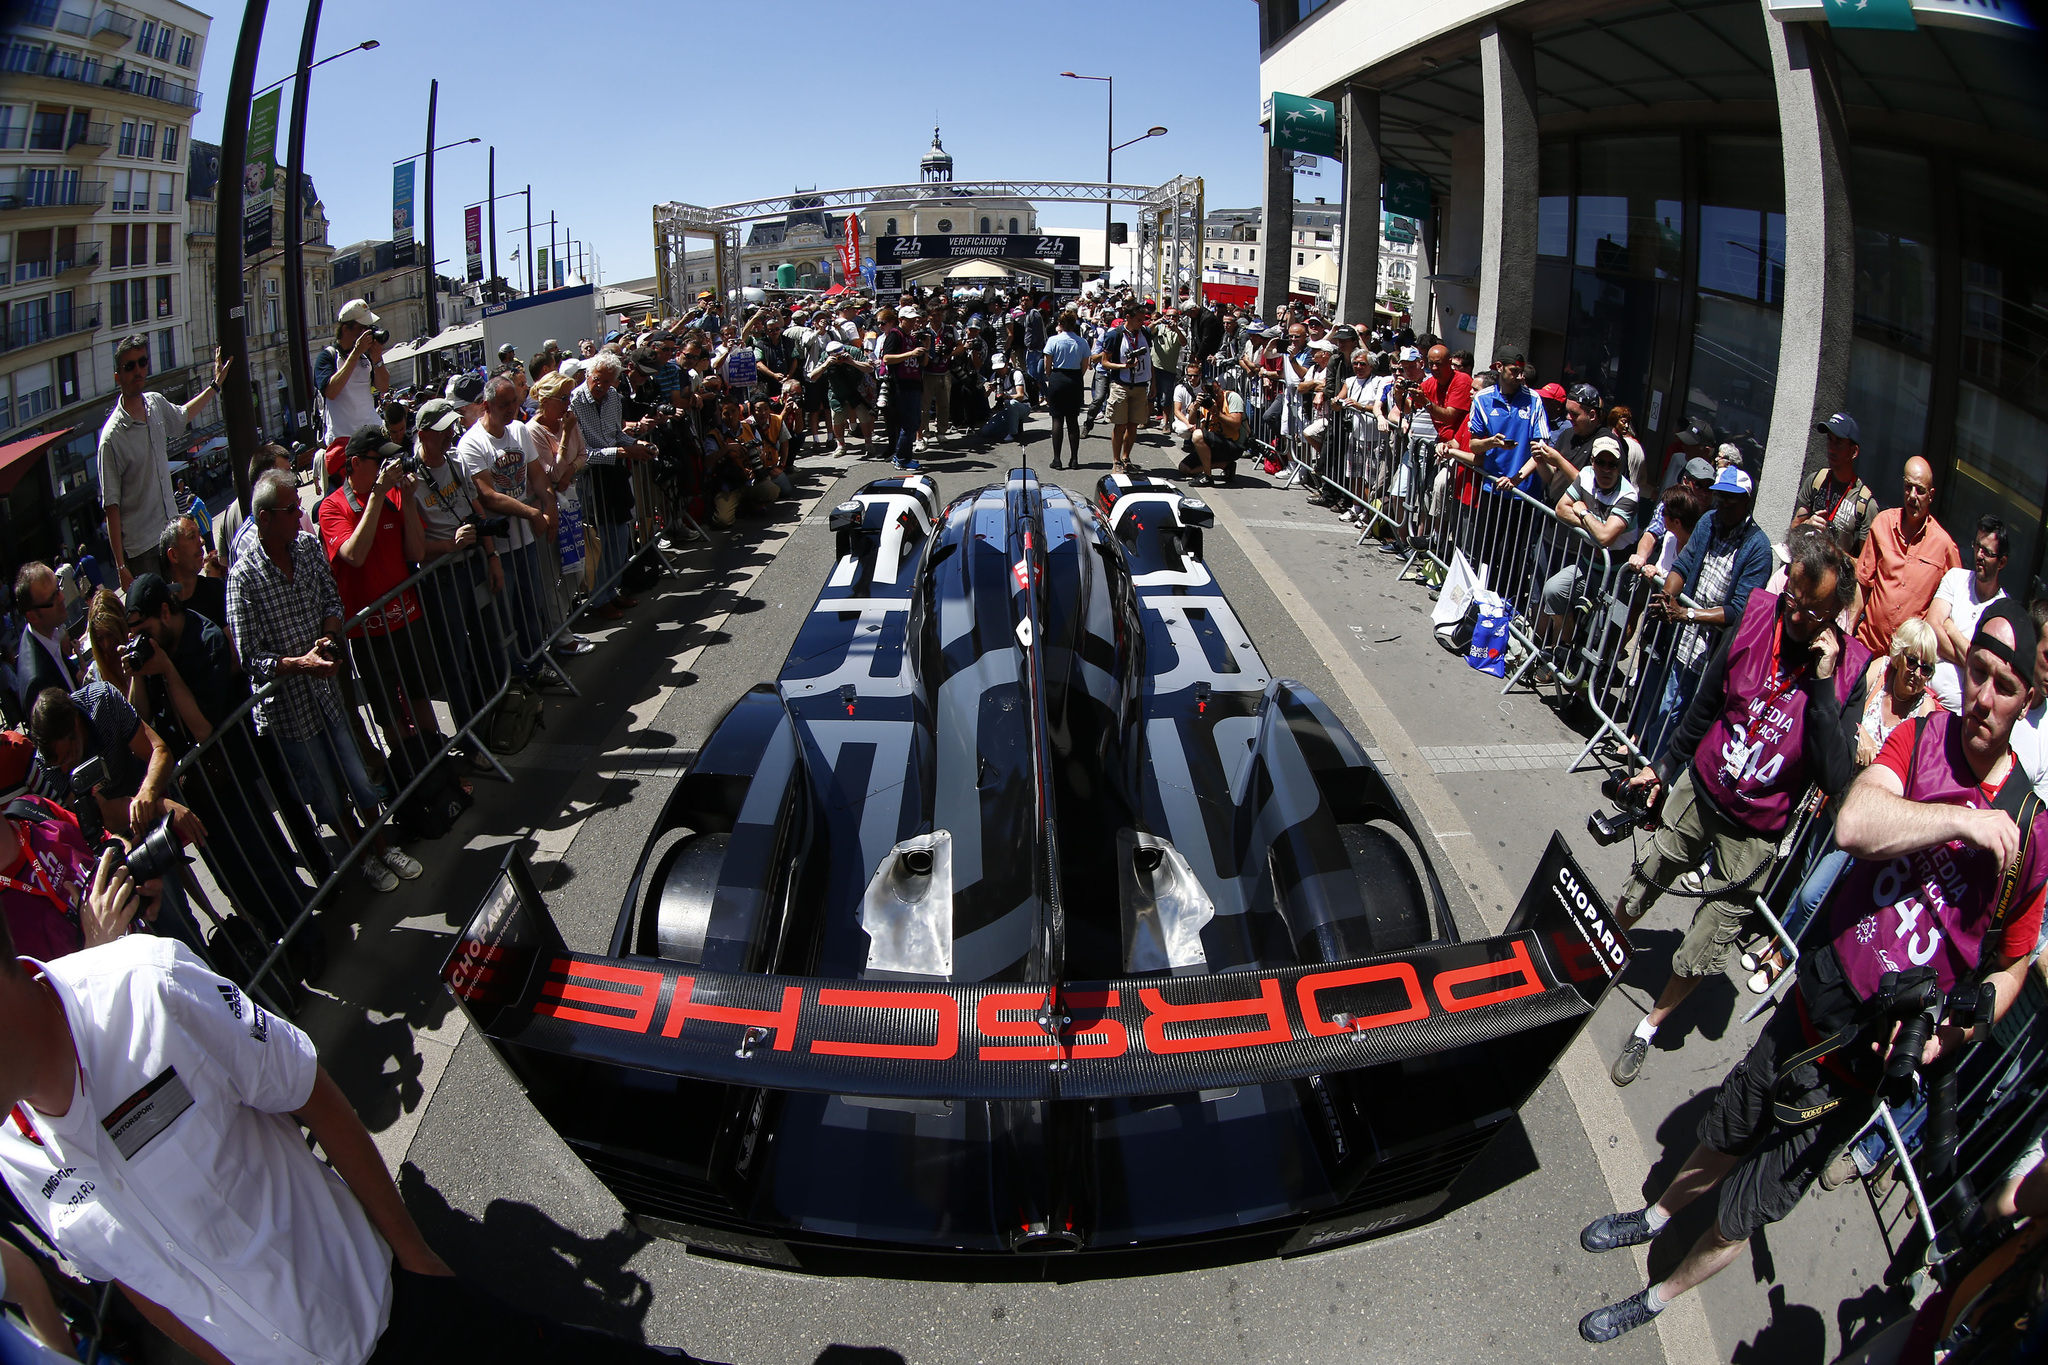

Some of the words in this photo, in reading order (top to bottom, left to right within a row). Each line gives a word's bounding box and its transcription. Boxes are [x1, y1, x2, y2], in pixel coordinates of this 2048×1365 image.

[893, 237, 922, 251] 24h
[949, 237, 1007, 246] VERIFICATIONS
[950, 246, 998, 256] TECHNIQUES
[1000, 246, 1005, 256] 1
[1035, 237, 1064, 251] 24h
[425, 495, 436, 508] LE
[1772, 686, 1793, 700] MNS
[1747, 715, 1782, 745] TACK
[1748, 697, 1794, 733] MEDIA
[1722, 723, 1785, 787] 344
[1913, 851, 1946, 912] TRACK
[1996, 880, 2014, 919] Nikon
[452, 883, 515, 988] CHOPARD
[1552, 885, 1574, 918] OFFICIAL
[1572, 914, 1591, 943] TIMING
[1588, 940, 1614, 979] PARTNER
[1559, 867, 1625, 966] CHOPARD
[464, 963, 486, 1002] OFFICIAL
[483, 934, 502, 965] TIMING
[499, 901, 522, 940] PARTNER
[231, 984, 242, 1020] adidas
[533, 940, 1546, 1061] PORSCHE
[104, 1088, 150, 1128] PORSCHE
[111, 1101, 156, 1141] MOTORSPORT
[1315, 1076, 1346, 1153] ICHELIN
[57, 1180, 96, 1223] CHOPARD
[1308, 1221, 1382, 1245] Mobil
